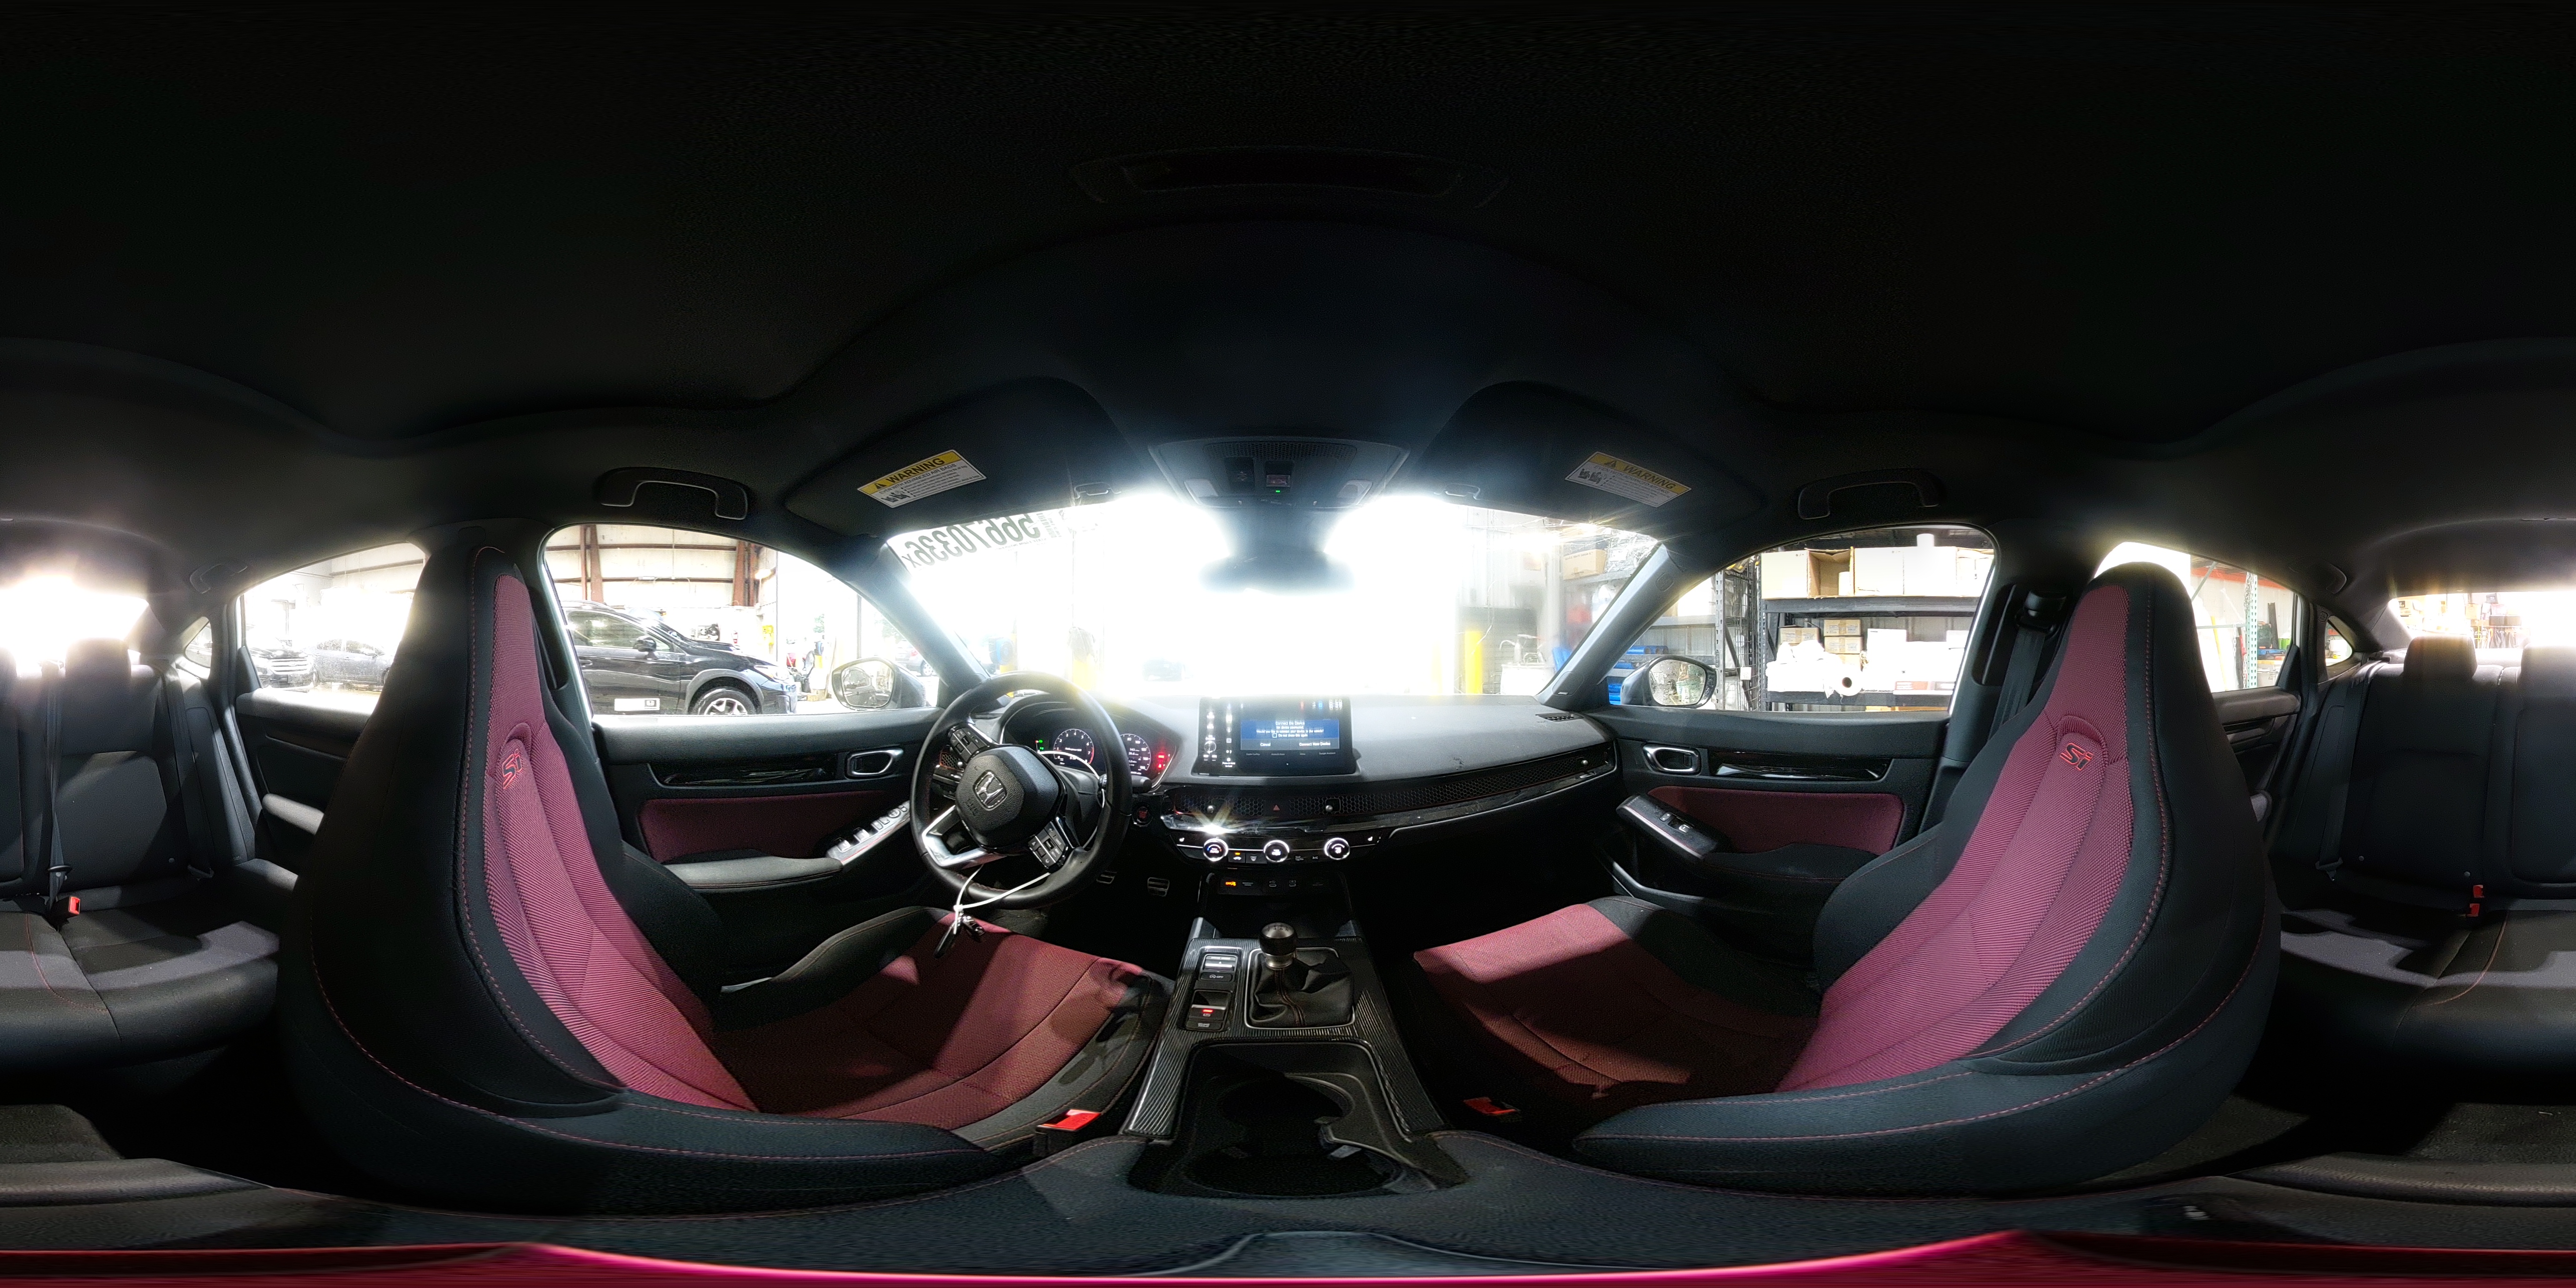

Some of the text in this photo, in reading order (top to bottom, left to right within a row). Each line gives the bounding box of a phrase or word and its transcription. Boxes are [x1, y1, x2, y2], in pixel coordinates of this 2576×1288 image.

[886, 458, 945, 483] WARNING
[1624, 465, 1676, 489] WARNING
[502, 748, 522, 790] Si
[2060, 743, 2094, 771] Si
